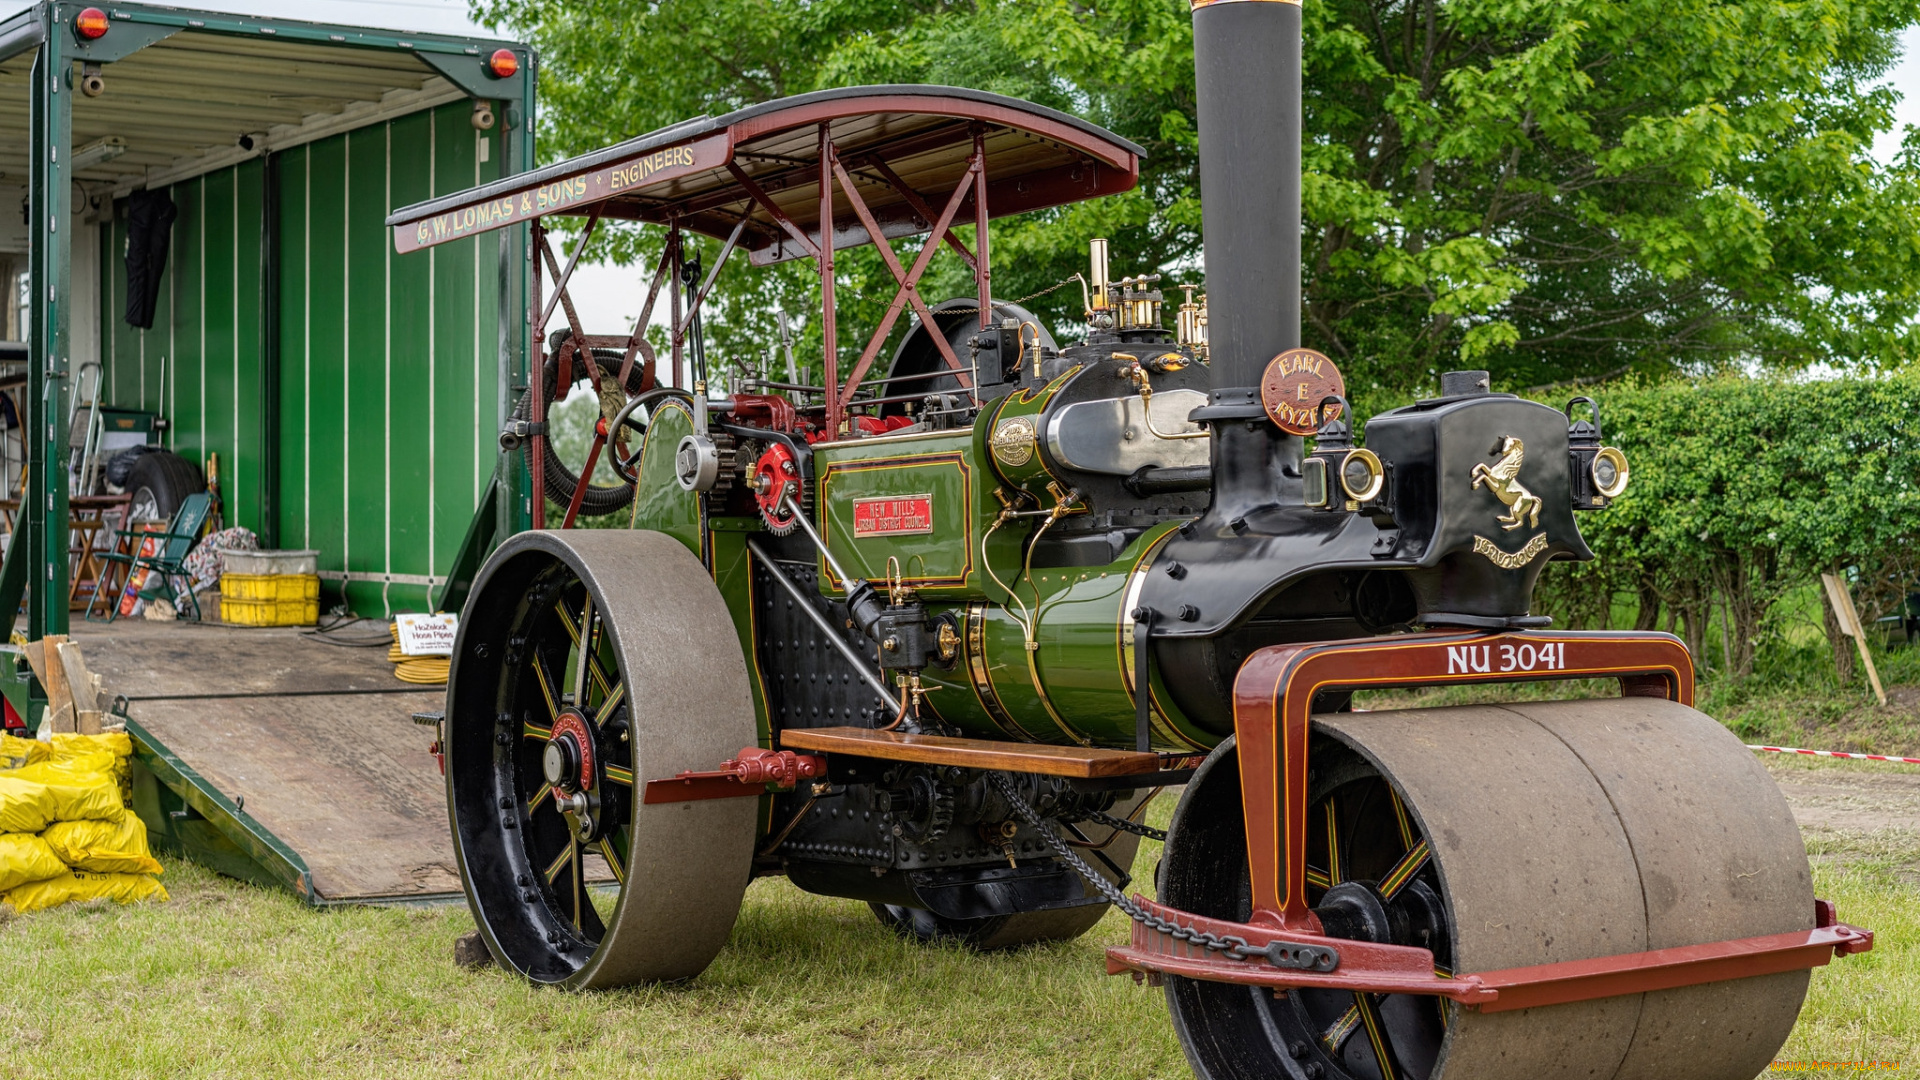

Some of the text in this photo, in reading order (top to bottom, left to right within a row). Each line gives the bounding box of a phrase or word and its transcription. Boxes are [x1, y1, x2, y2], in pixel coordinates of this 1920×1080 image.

[520, 191, 532, 215] &
[536, 174, 587, 212] SONS
[610, 146, 694, 189] ENGINEERS
[1278, 354, 1324, 379] EARL
[1297, 382, 1309, 401] E
[869, 500, 915, 518] NEW MILLS
[1447, 642, 1565, 674] NU 3041
